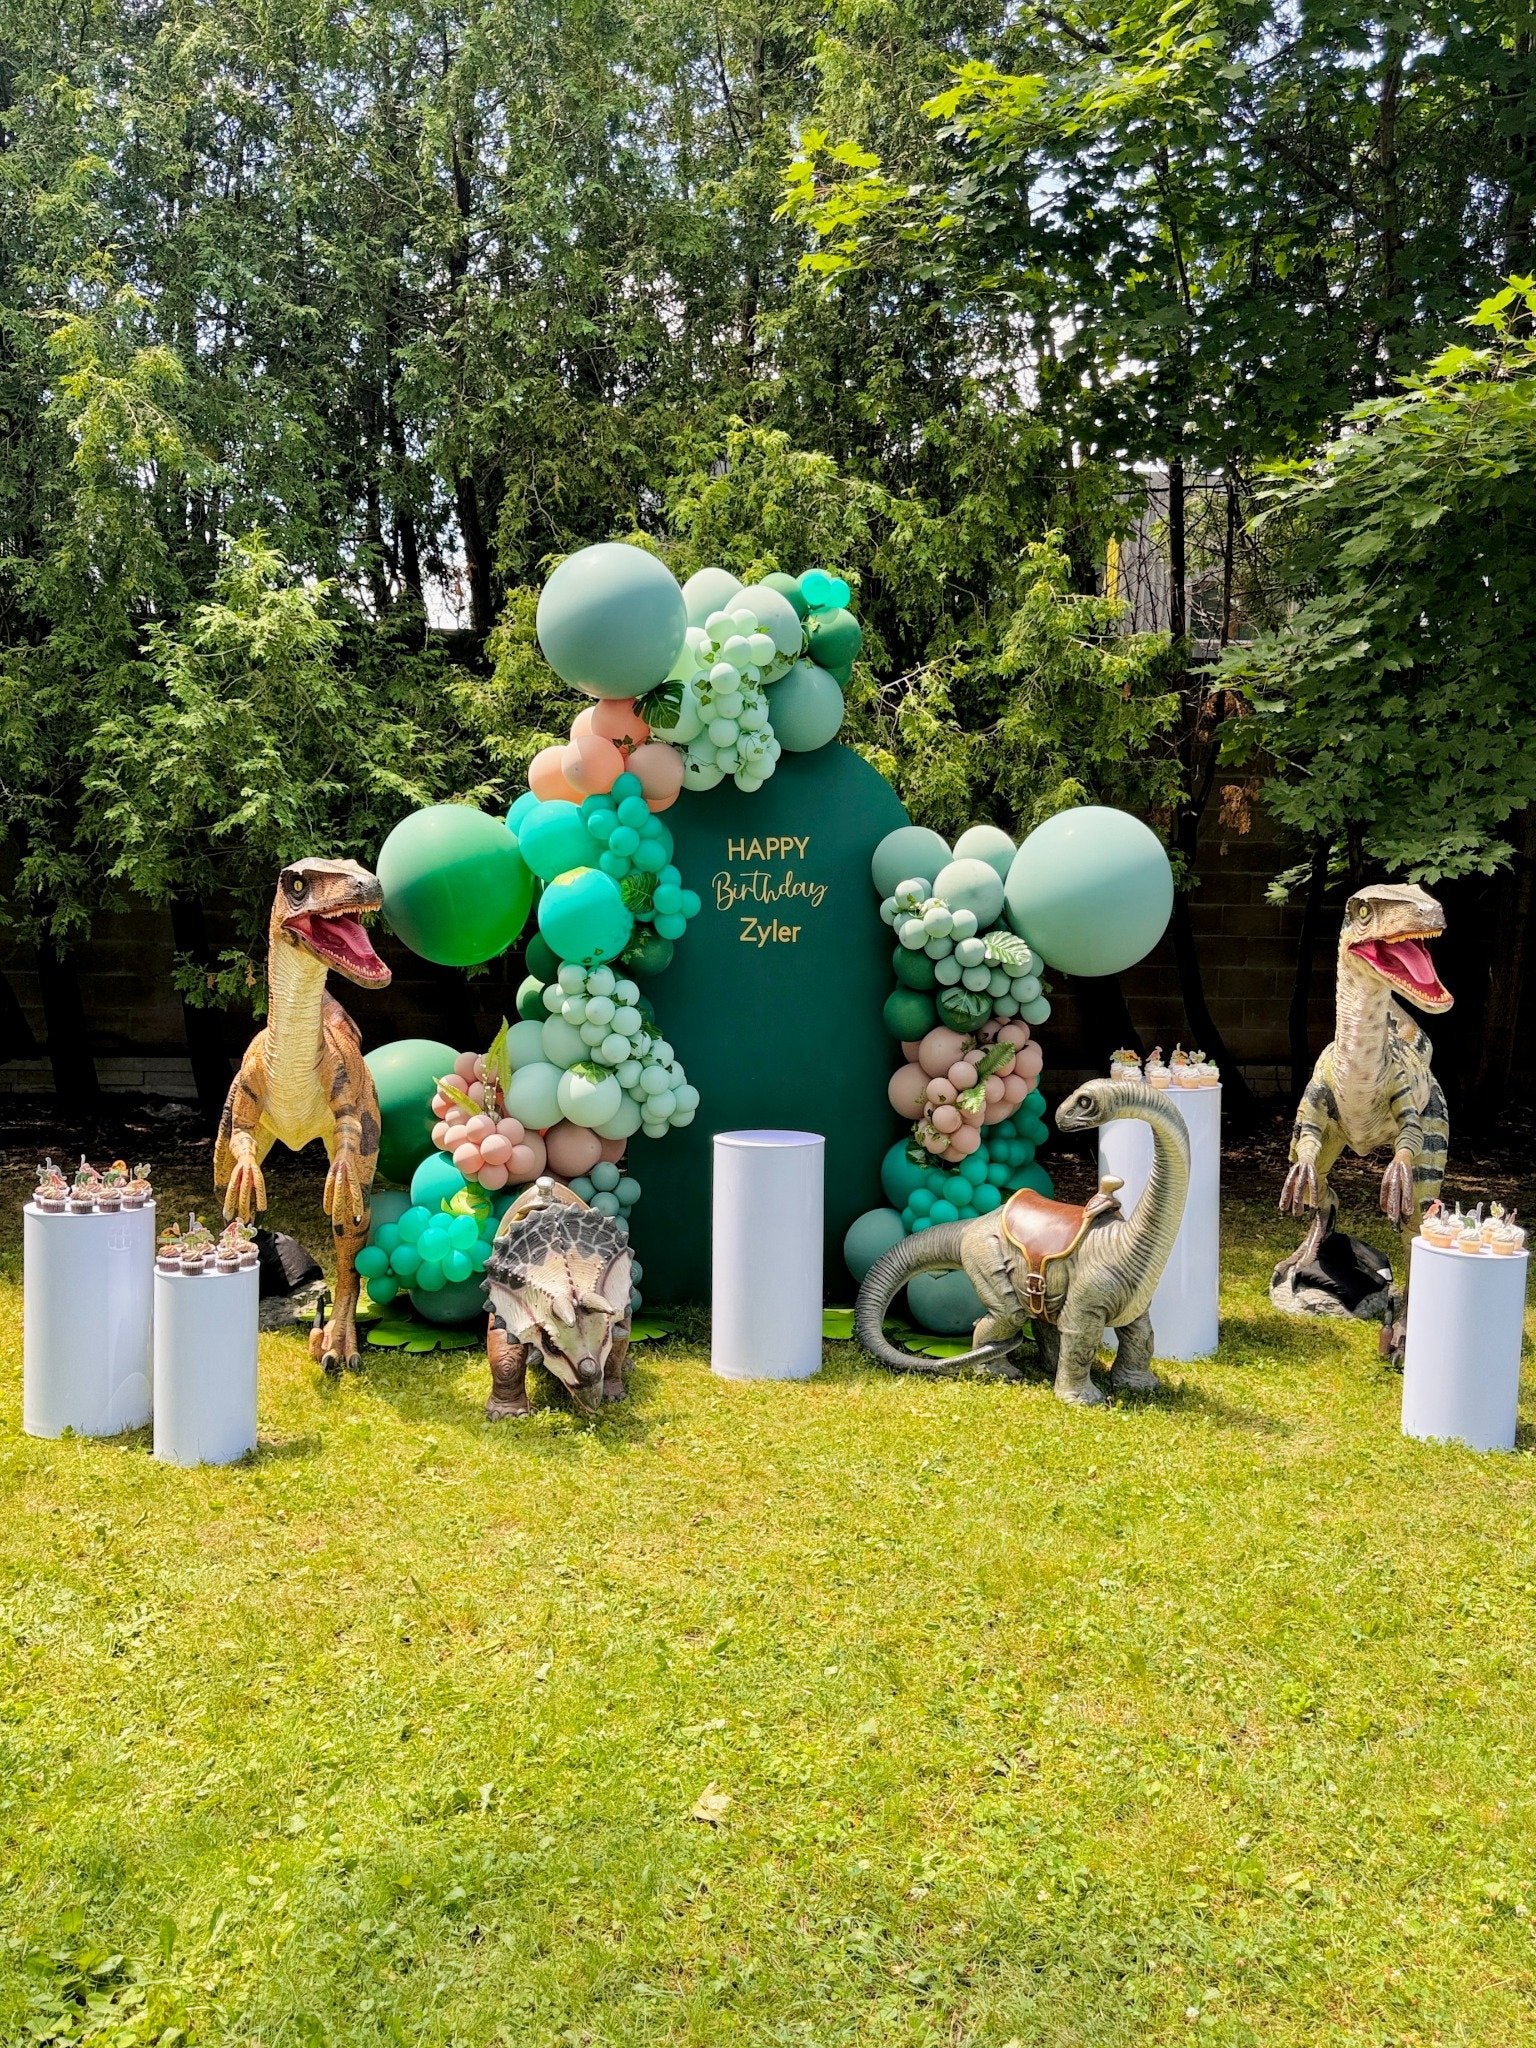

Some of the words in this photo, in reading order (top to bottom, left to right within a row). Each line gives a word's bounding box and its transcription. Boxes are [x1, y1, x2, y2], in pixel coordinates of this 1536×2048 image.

[727, 836, 811, 861] HAPPY
[712, 870, 829, 911] Birthday
[739, 917, 802, 949] Zyler
